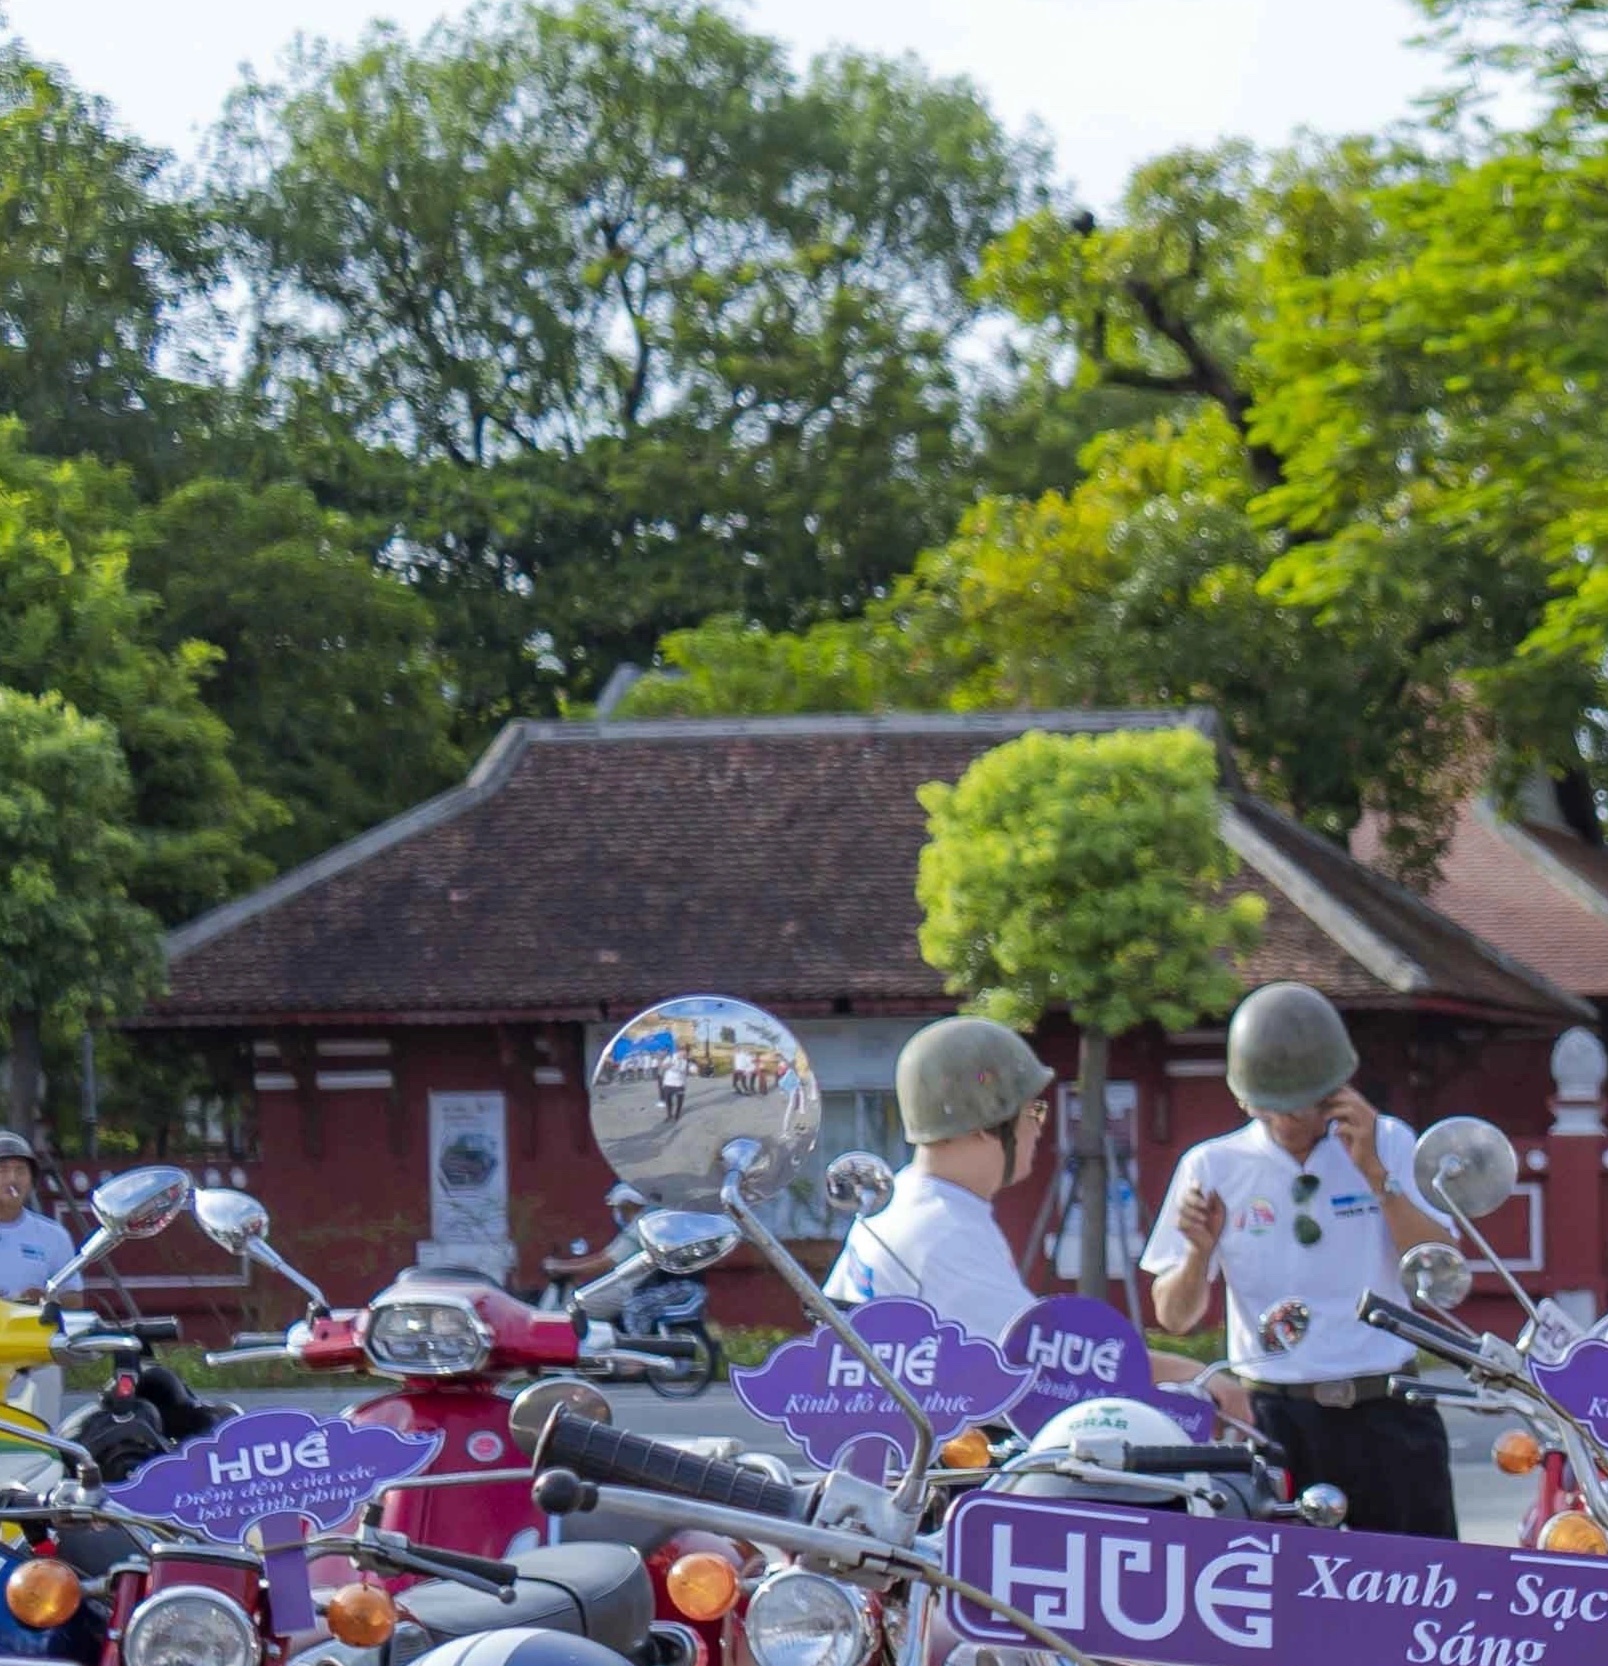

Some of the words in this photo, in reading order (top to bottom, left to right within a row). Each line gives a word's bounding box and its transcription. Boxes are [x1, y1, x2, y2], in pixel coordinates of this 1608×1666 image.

[785, 1391, 840, 1414] Kinh
[991, 1524, 1281, 1649] HUẾ
[1299, 1554, 1458, 1610] Xanh
